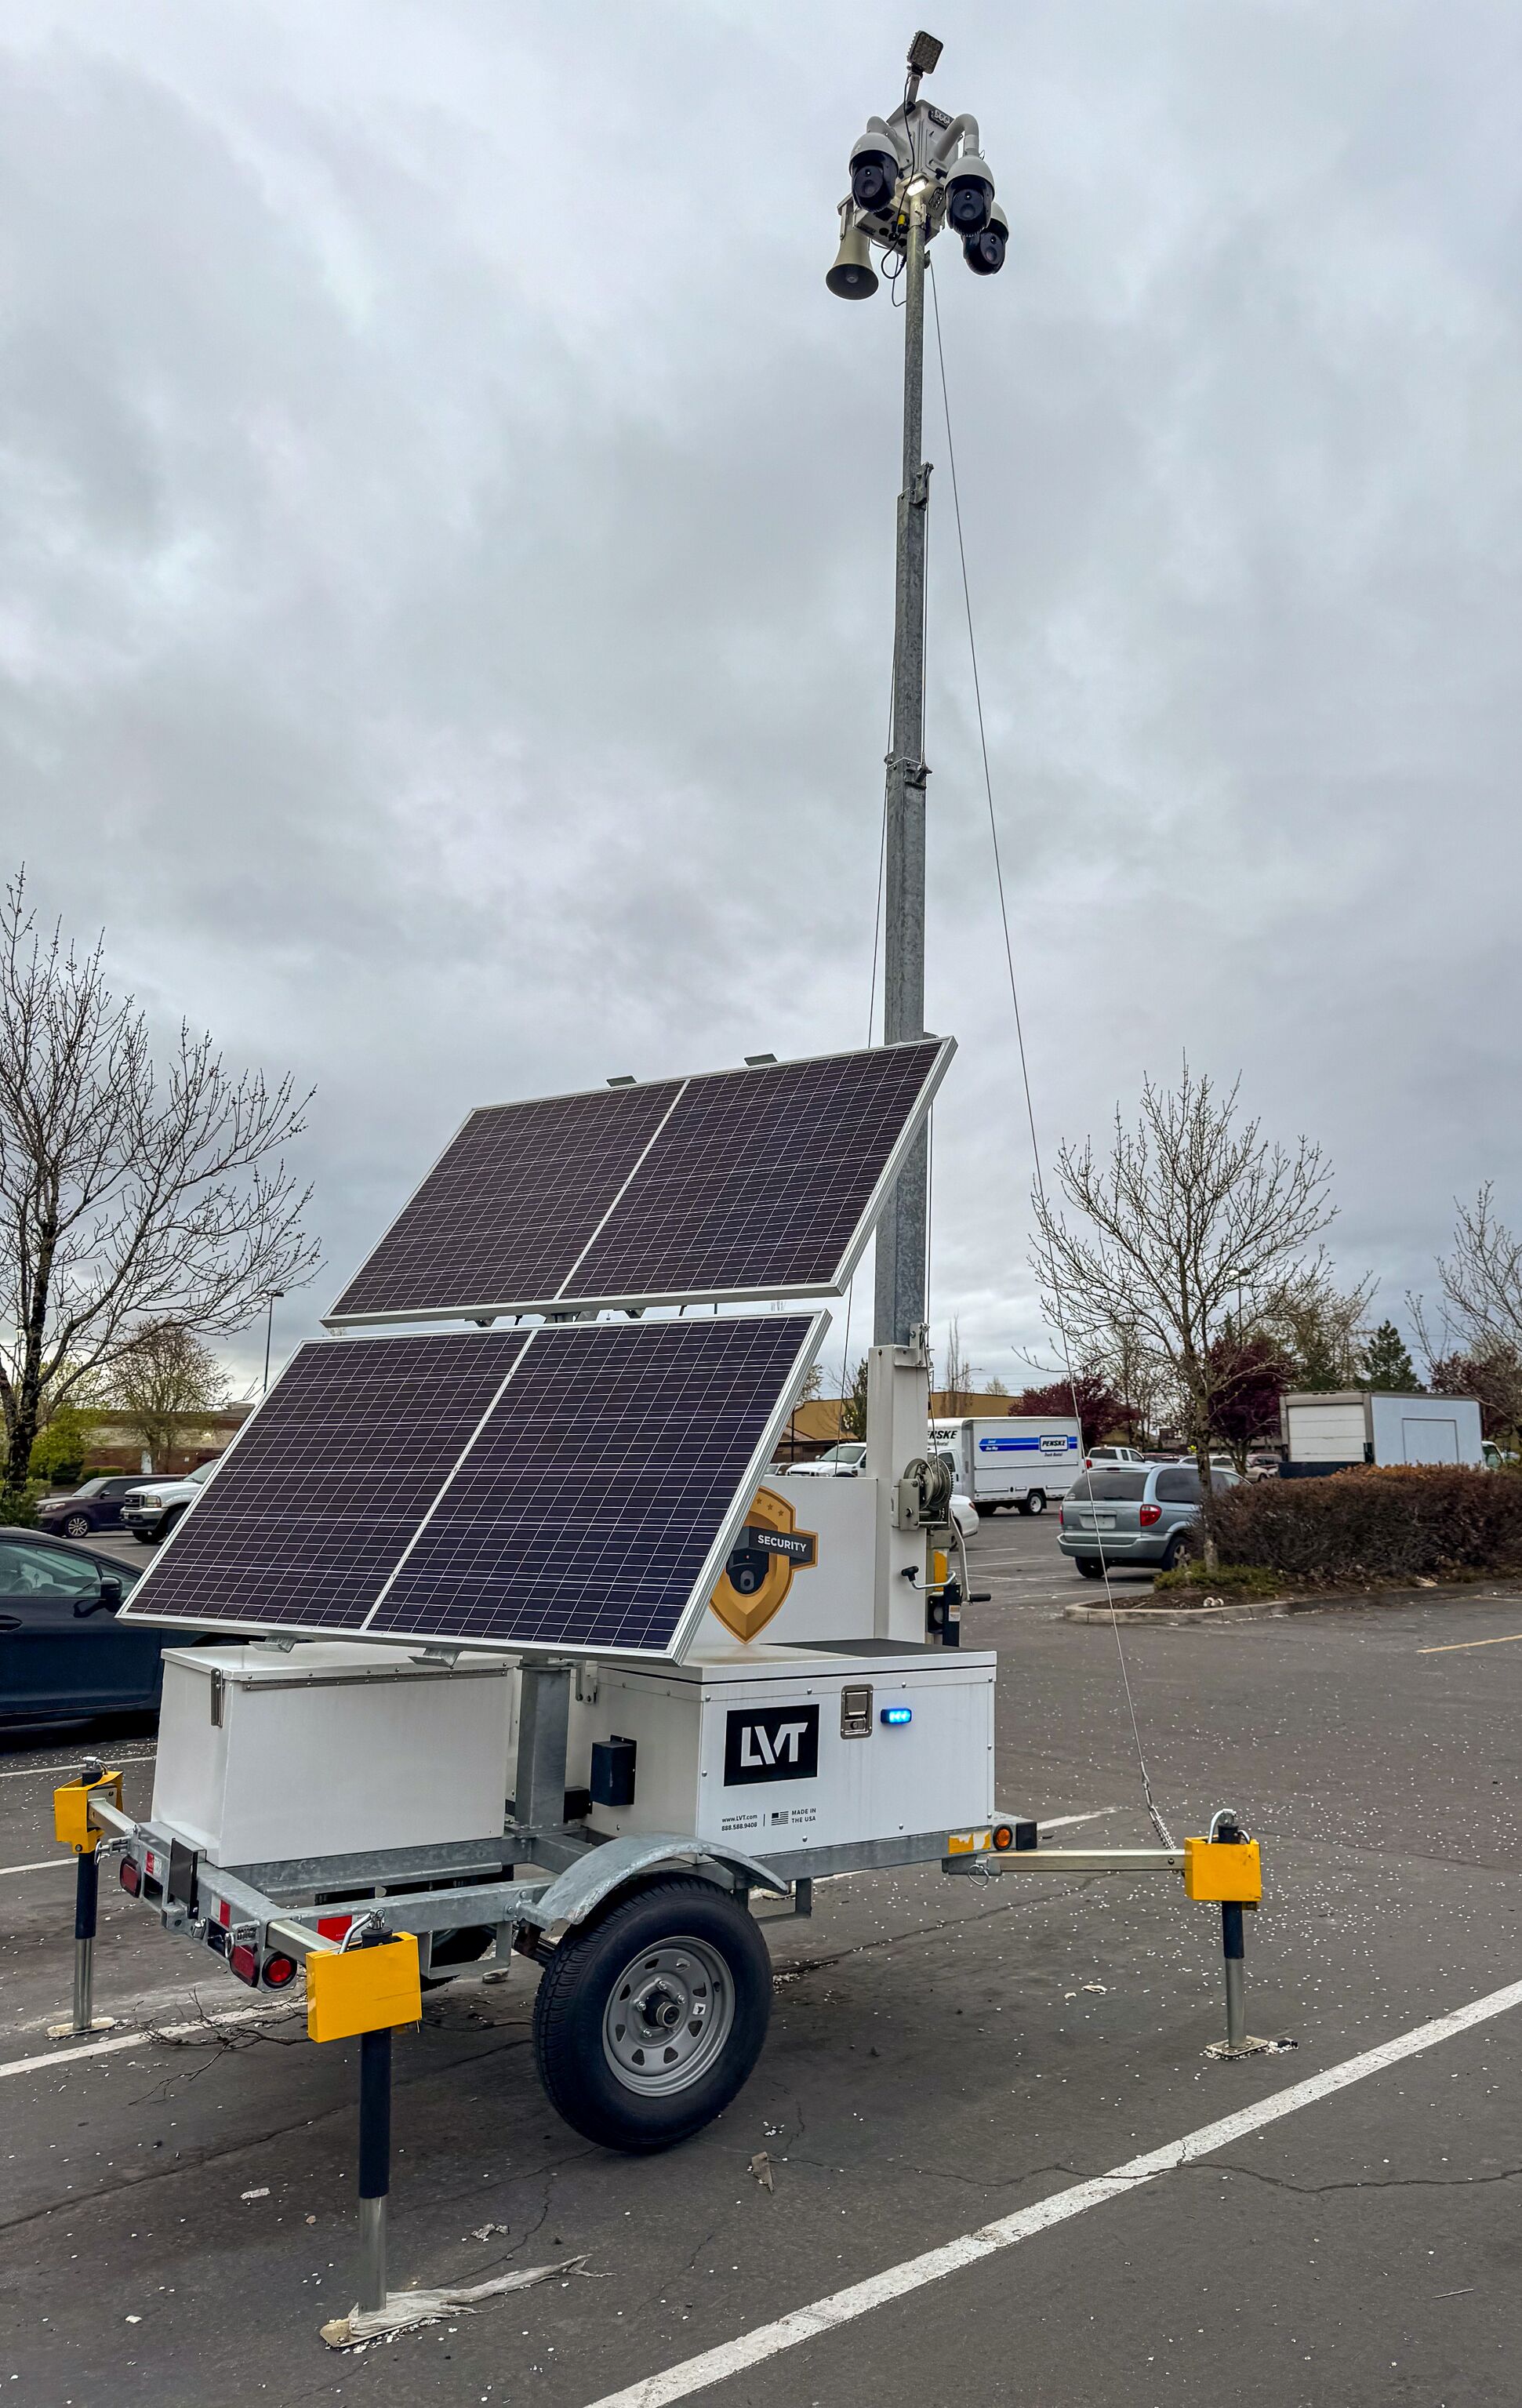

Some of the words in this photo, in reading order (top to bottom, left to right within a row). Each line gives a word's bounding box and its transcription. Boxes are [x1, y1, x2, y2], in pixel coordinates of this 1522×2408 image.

[928, 1430, 957, 1439] NSKE
[757, 1535, 807, 1553] SECURITY
[740, 1722, 808, 1767] LVT
[721, 1814, 758, 1823] www.LVT.com
